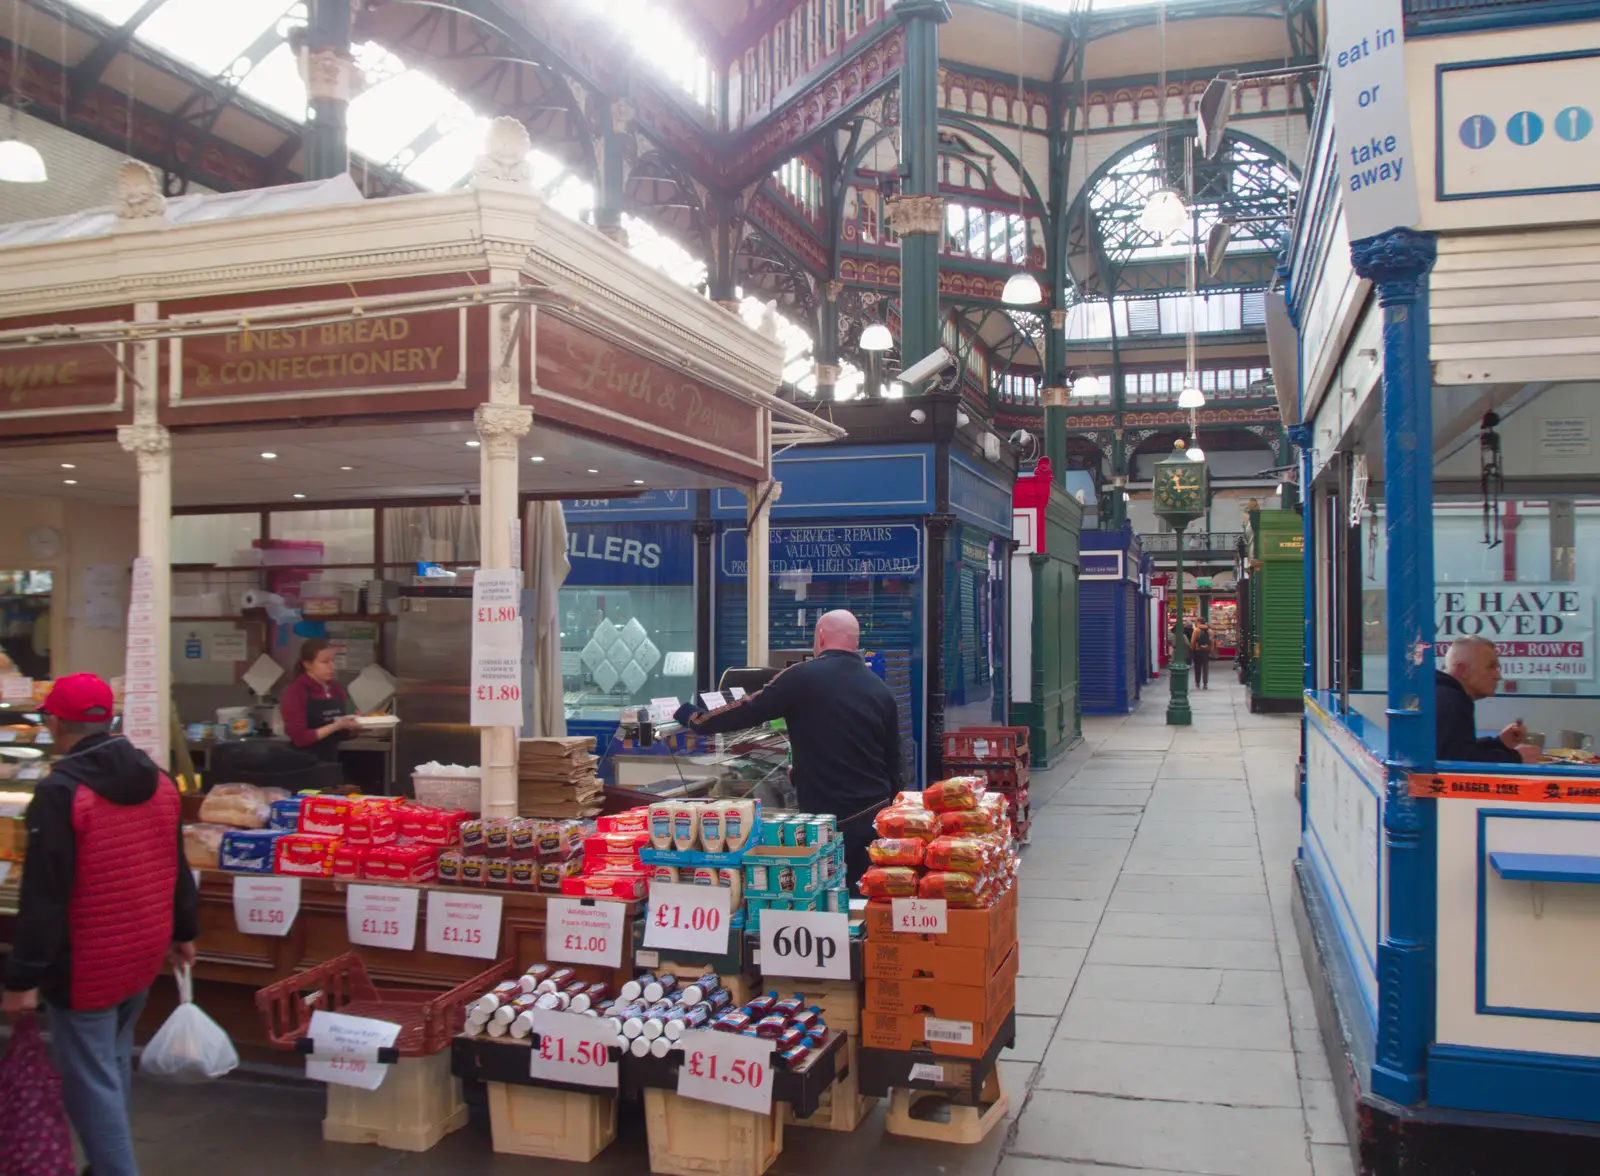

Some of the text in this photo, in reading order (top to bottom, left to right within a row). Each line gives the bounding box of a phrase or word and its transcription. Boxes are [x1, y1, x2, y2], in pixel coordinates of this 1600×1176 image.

[1337, 28, 1396, 68] eat in
[1358, 85, 1380, 108] or
[1350, 135, 1397, 166] take
[1350, 157, 1404, 192] away
[225, 318, 409, 353] FINEST BREAD
[195, 346, 444, 387] & CONFECTIONERY
[0, 360, 79, 403] yne
[571, 345, 652, 405] Firth
[656, 383, 679, 412] &
[790, 528, 835, 543] SERVICE
[844, 528, 892, 542] REPAIRS
[566, 532, 662, 569] LLERS
[785, 543, 852, 557] VALUATIONS
[731, 557, 911, 573] PROCED AT A HIGH STANDARD
[1478, 591, 1580, 613] HAVE
[477, 605, 516, 622] £1.80
[1527, 644, 1566, 656] ROW
[1567, 644, 1580, 656] G
[1499, 662, 1587, 675] 113 244 5010
[476, 684, 520, 701] £1.80
[248, 908, 284, 924] £1.50
[911, 901, 917, 910] 2
[361, 918, 400, 936] £1.15
[654, 903, 721, 932] £1.00
[901, 915, 938, 928] £1.00
[442, 926, 482, 944] £1.15
[564, 934, 607, 953] £1.00
[773, 925, 837, 968] 60p
[538, 1034, 608, 1068] £1.50
[687, 1050, 763, 1088] £1.50
